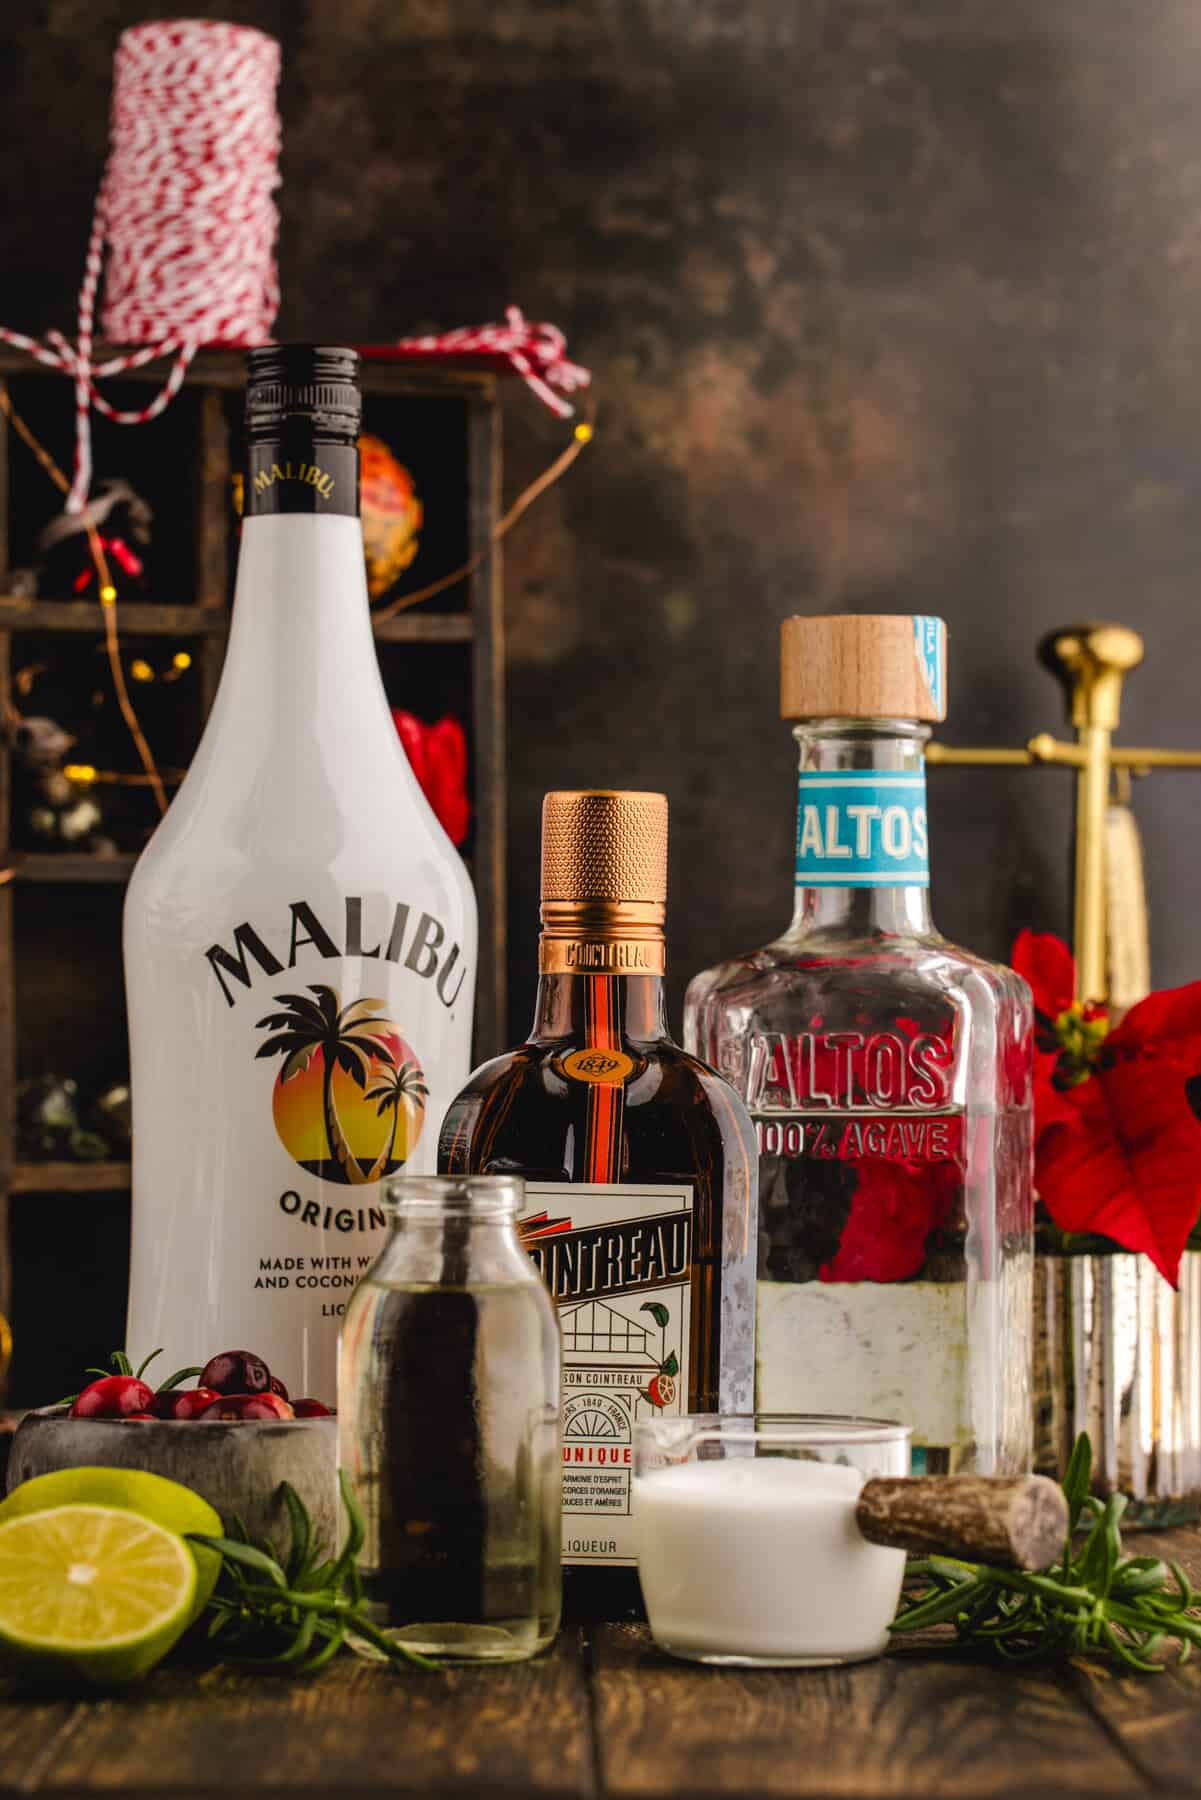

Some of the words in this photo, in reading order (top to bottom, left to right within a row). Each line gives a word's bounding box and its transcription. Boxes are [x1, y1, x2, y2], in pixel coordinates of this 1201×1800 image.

[254, 463, 336, 496] MALIBU
[799, 804, 928, 859] ALTOS
[205, 896, 466, 1008] MALIBU
[747, 1032, 948, 1111] ALTOS
[837, 1123, 950, 1162] AGAVE
[279, 1190, 387, 1232] ORIGIN
[259, 1257, 305, 1271] MADE
[311, 1256, 351, 1270] WITH
[254, 1276, 290, 1289] AND
[295, 1274, 360, 1289] COCON
[586, 1374, 643, 1385] COINTREAU
[562, 1447, 632, 1465] UNIQUE
[562, 1540, 617, 1553] IQUEUR
